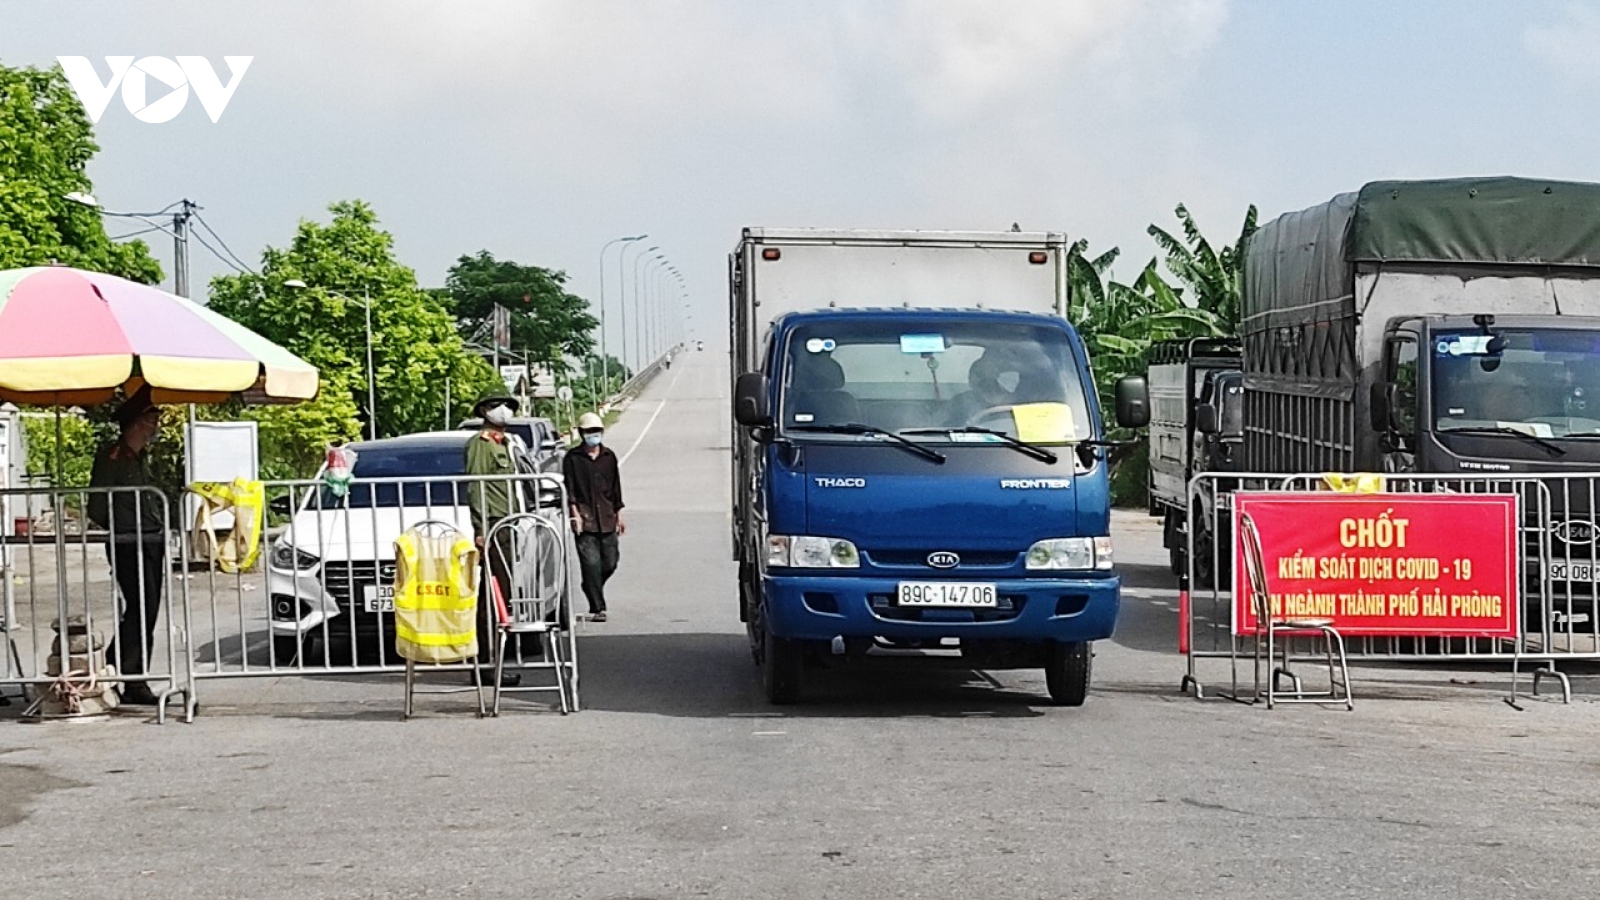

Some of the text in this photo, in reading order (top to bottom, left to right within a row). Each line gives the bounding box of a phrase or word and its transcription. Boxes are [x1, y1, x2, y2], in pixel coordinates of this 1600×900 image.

[815, 478, 866, 487] THACO
[1001, 479, 1070, 488] FRONTIER
[1340, 508, 1409, 548] CHỐT
[1278, 548, 1316, 579] KIỂM
[1319, 553, 1356, 579] SOÁT
[1359, 557, 1393, 584] DỊCH
[1396, 557, 1440, 580] COVID
[1453, 558, 1472, 580] 19
[379, 586, 395, 597] 30
[370, 599, 394, 610] 673
[1284, 588, 1336, 616] NGÀNH
[1338, 588, 1386, 616] THÀNH
[1389, 586, 1419, 616] PHỐ
[1422, 587, 1448, 616] HẢI
[1450, 590, 1502, 617] PHÒNG
